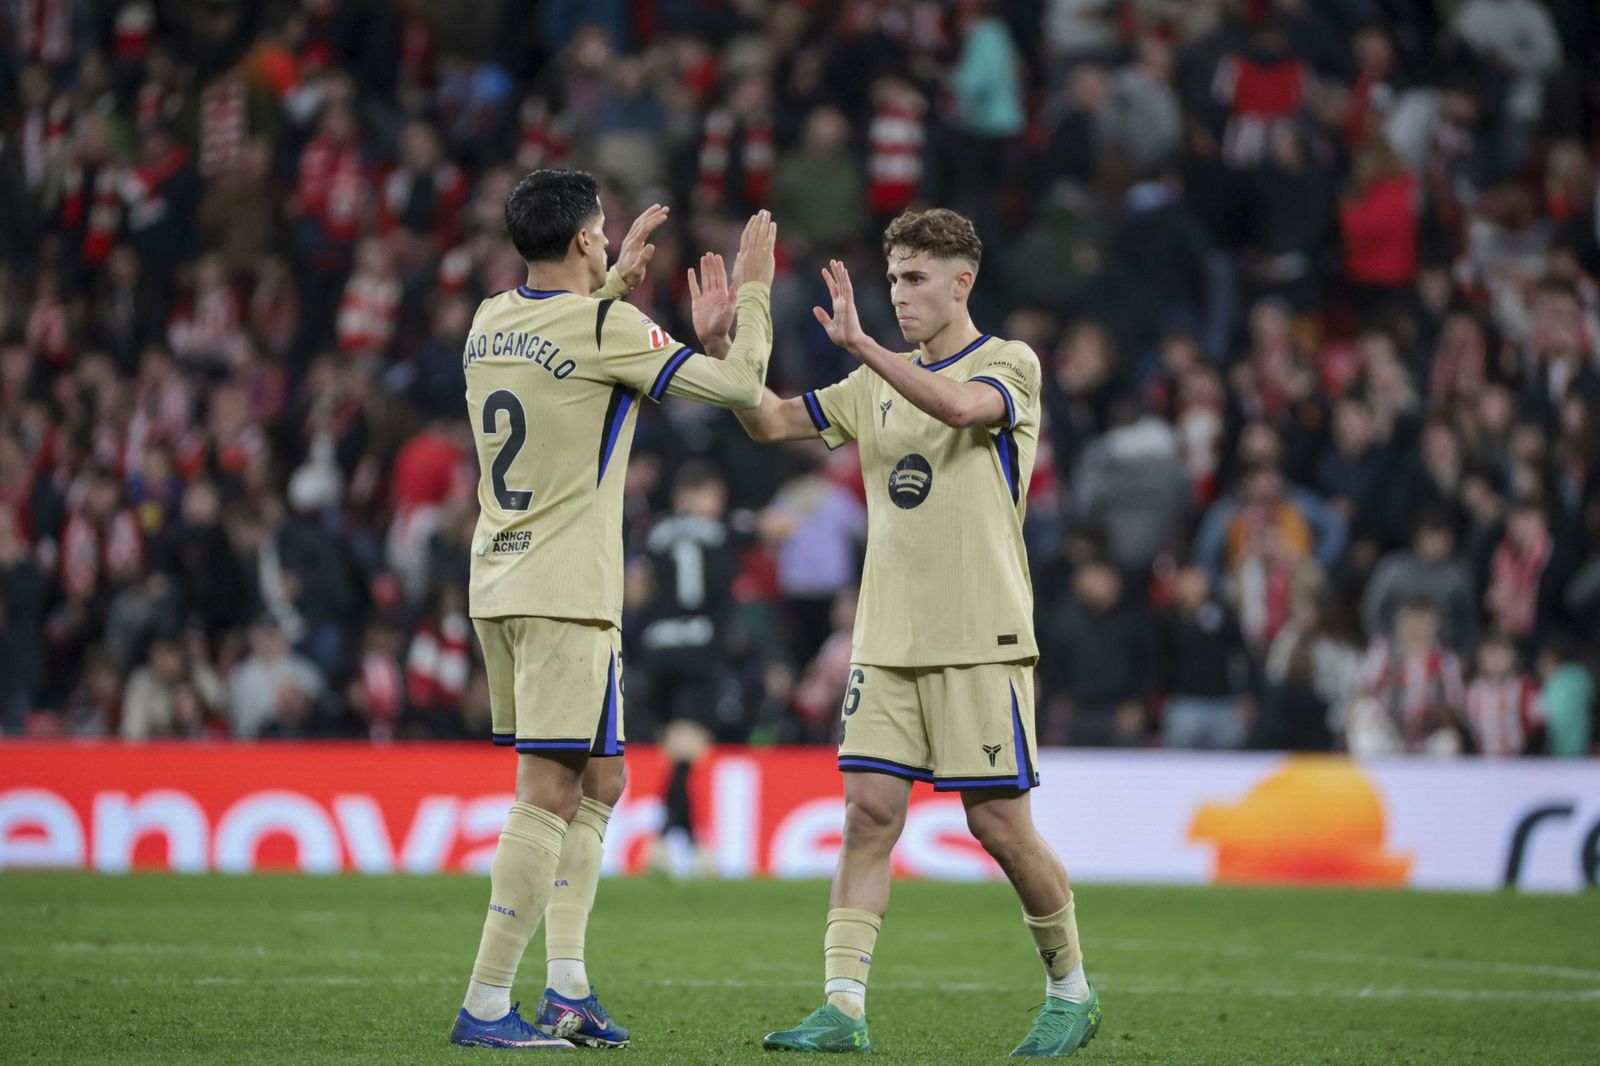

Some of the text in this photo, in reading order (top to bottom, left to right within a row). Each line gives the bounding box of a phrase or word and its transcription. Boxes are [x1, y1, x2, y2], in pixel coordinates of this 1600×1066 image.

[492, 331, 576, 380] CANCELO
[482, 388, 534, 512] 2
[492, 541, 530, 553] ACNUR
[674, 537, 705, 611] 1
